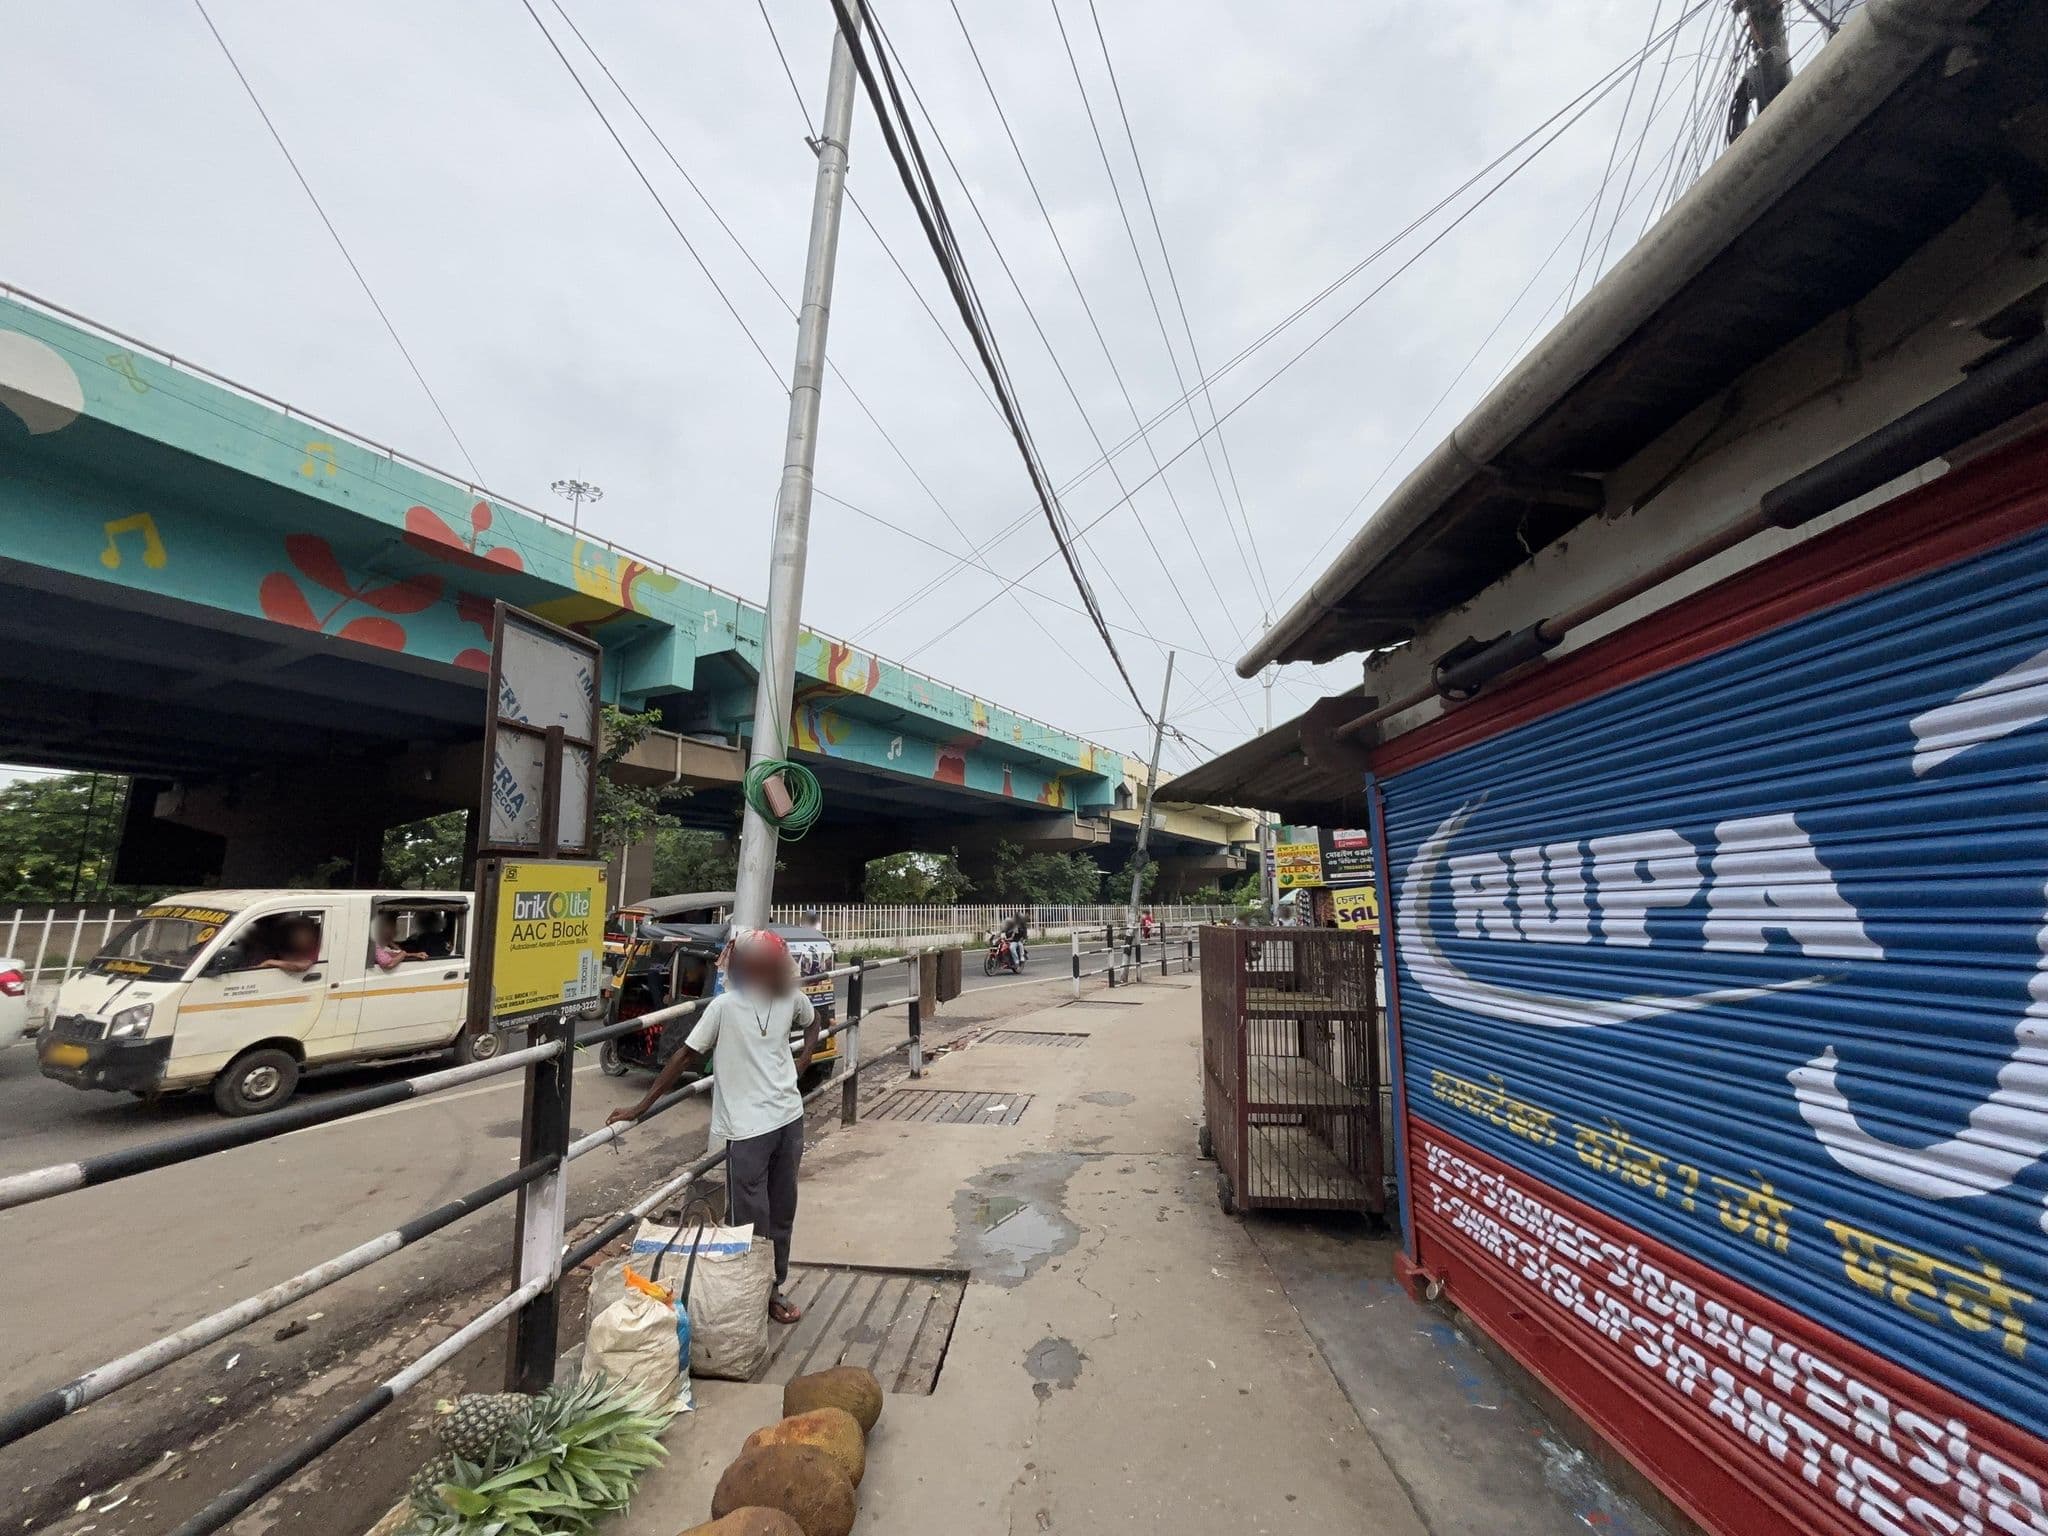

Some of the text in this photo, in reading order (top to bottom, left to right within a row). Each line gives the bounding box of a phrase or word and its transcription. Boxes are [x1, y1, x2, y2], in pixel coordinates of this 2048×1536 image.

[1281, 866, 1309, 874] ALEX
[1449, 812, 1886, 960] RUPA
[511, 920, 589, 943] AAC Block
[527, 993, 560, 1004] CONSTRUCTION
